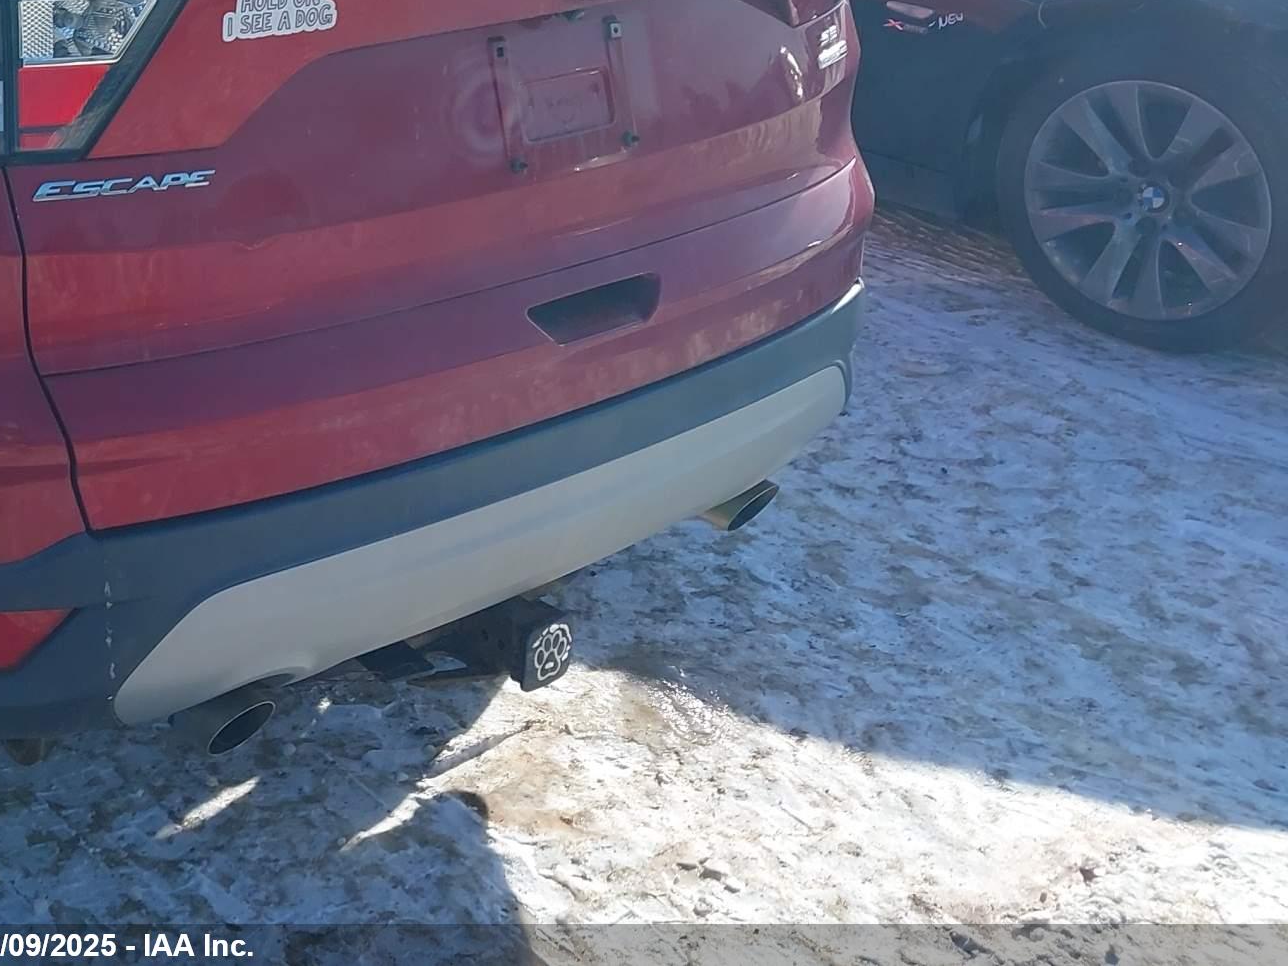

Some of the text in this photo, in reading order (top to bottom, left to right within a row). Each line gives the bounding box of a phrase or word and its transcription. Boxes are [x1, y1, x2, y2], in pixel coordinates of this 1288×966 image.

[227, 4, 333, 37] I SEE A DOG
[32, 169, 217, 202] ESCAPE
